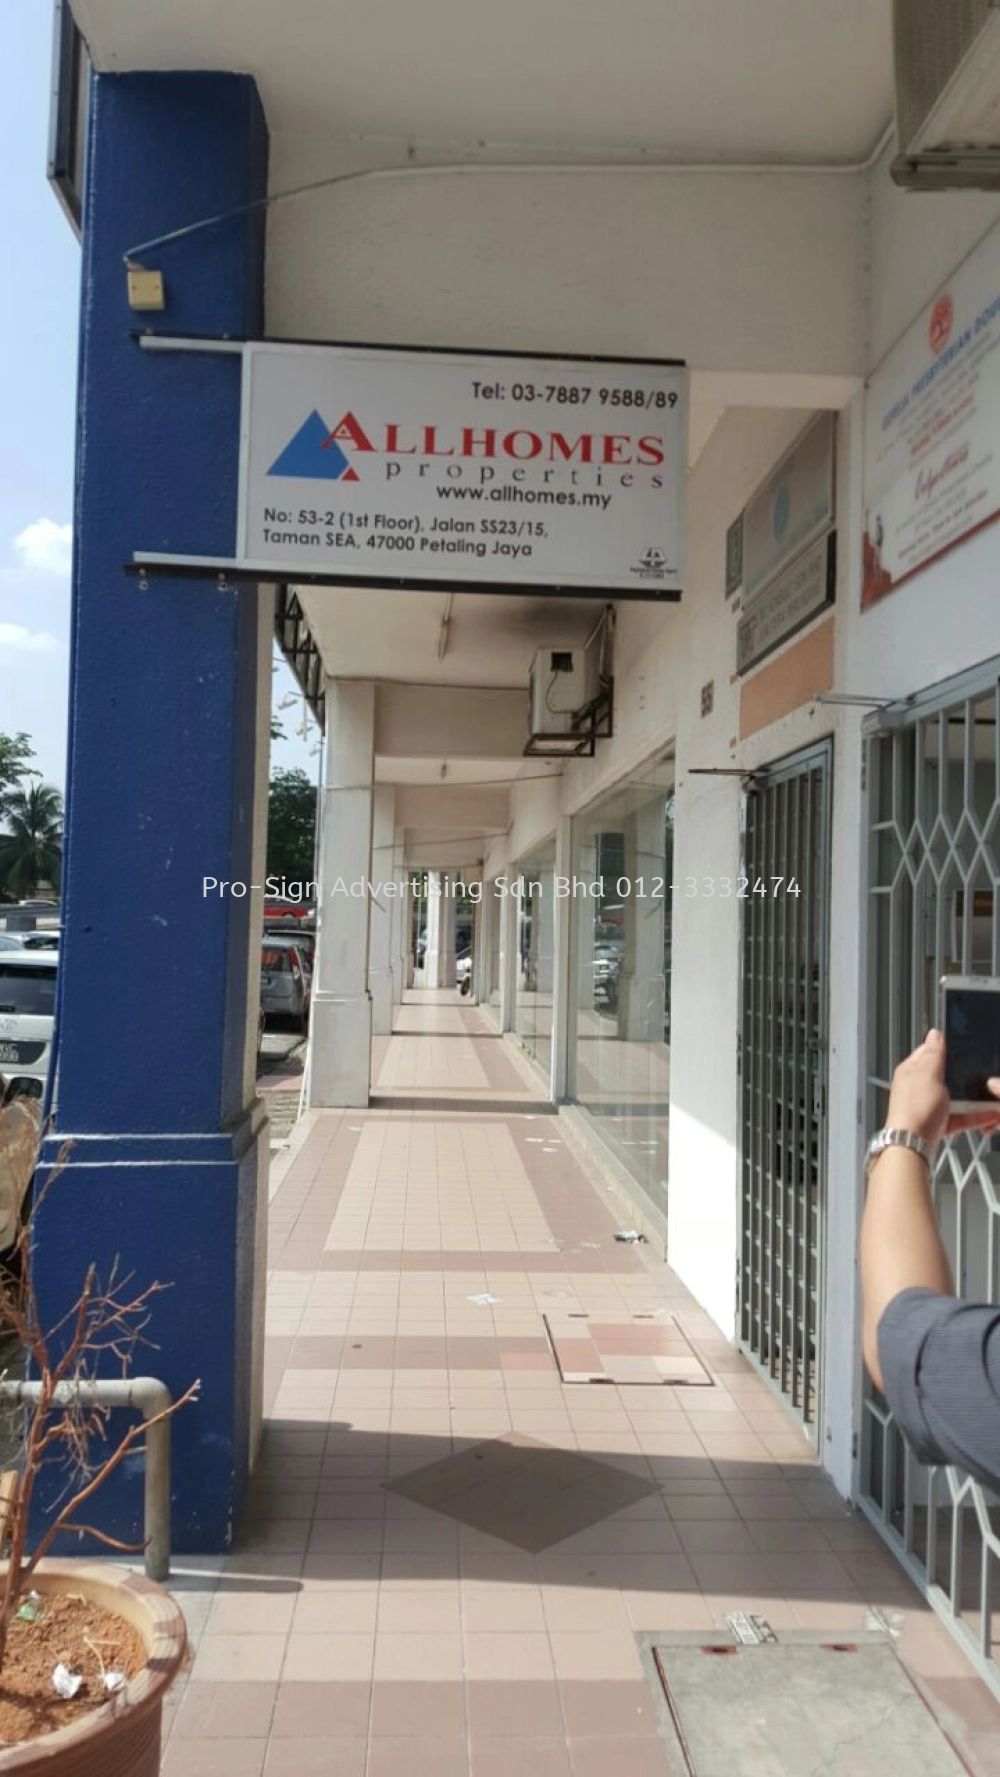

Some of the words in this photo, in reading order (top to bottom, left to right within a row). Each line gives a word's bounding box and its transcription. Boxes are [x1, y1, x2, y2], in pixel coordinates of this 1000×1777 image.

[472, 381, 505, 400] Tel:
[511, 383, 592, 404] 03-7887
[598, 388, 679, 410] 9588/89
[319, 410, 665, 466] ALLHOMES
[386, 461, 664, 489] properties
[436, 483, 612, 510] www.allhomes.my
[264, 507, 292, 523] No:
[299, 510, 334, 526] 53-2
[339, 512, 369, 531] (1st
[431, 517, 475, 533] Jalan
[480, 519, 549, 538] SS23/15,
[263, 528, 320, 545] Taman
[326, 532, 360, 549] SEA,
[366, 534, 415, 551] 47000
[420, 537, 487, 557] Petaling
[492, 541, 533, 558] Jaya
